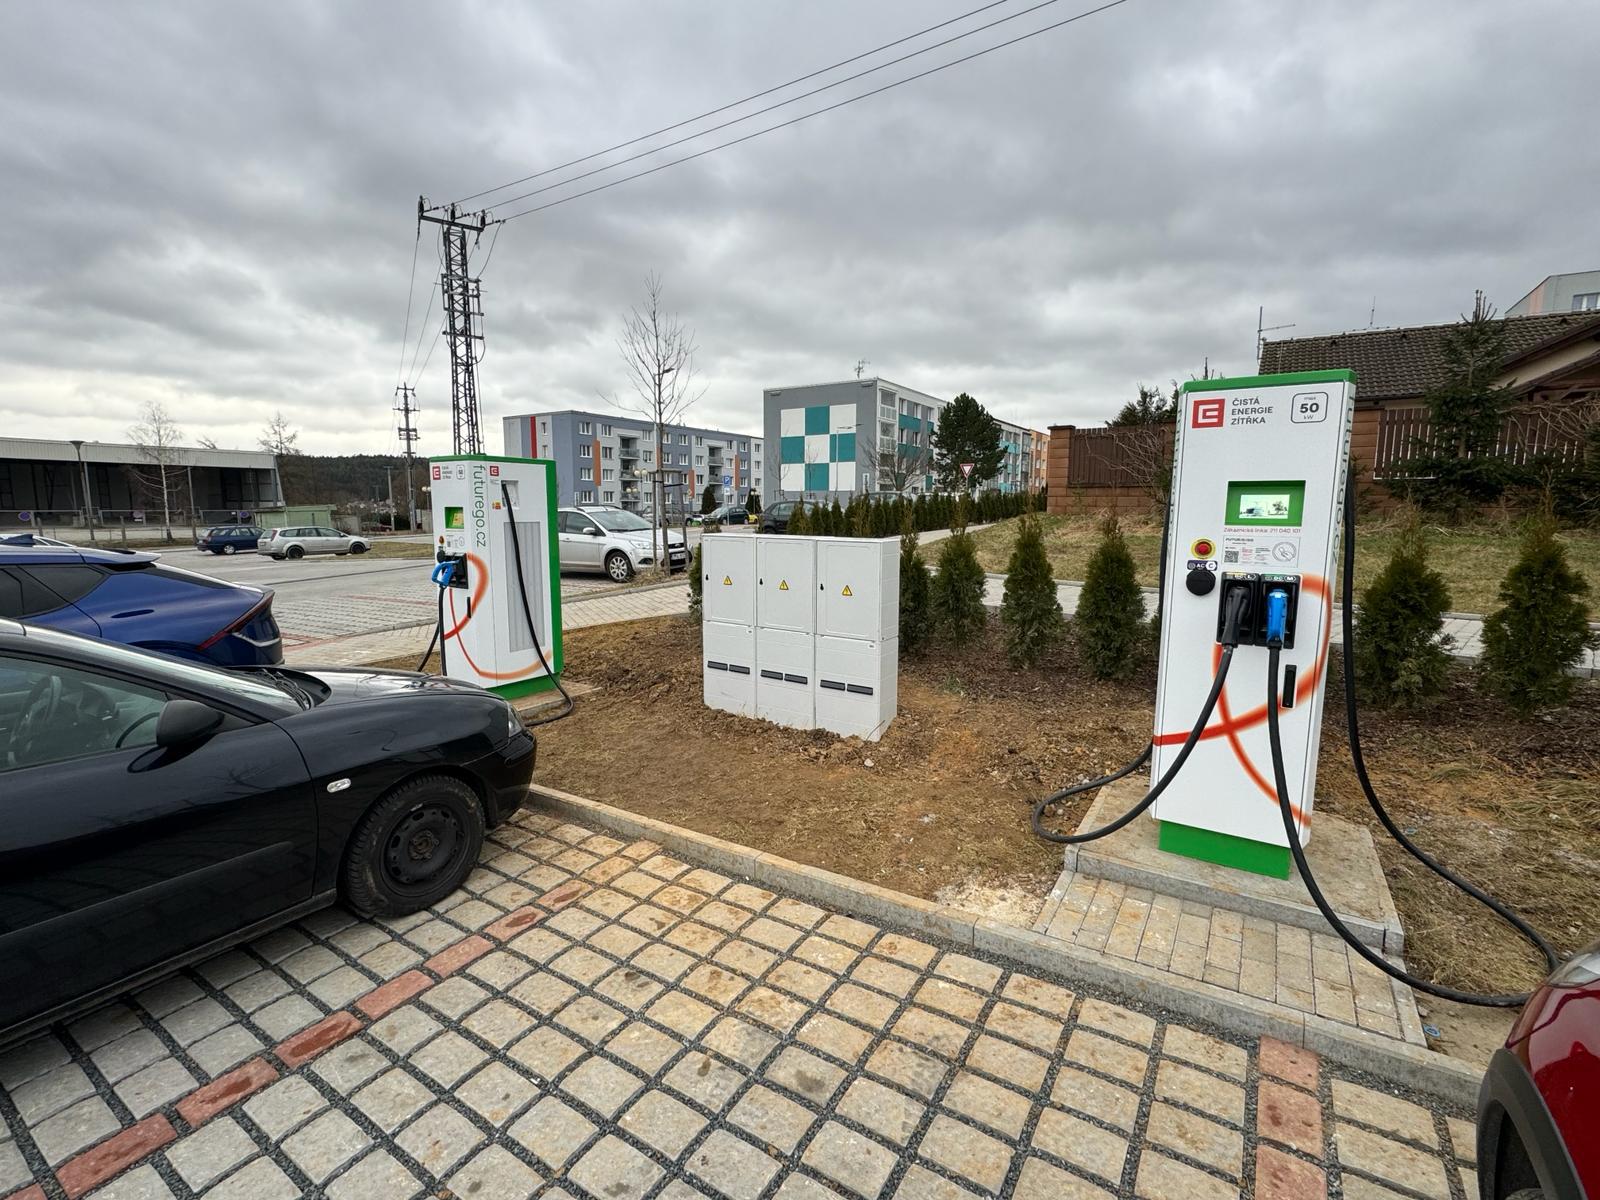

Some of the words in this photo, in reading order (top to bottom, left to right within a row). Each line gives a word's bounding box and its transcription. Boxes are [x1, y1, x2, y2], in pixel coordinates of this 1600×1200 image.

[1232, 396, 1260, 407] ČISTÁ
[1231, 406, 1274, 416] ENERGIE
[1299, 402, 1320, 414] 50
[1230, 416, 1266, 426] ZÍTŘKA
[472, 465, 486, 548] futurego.cz
